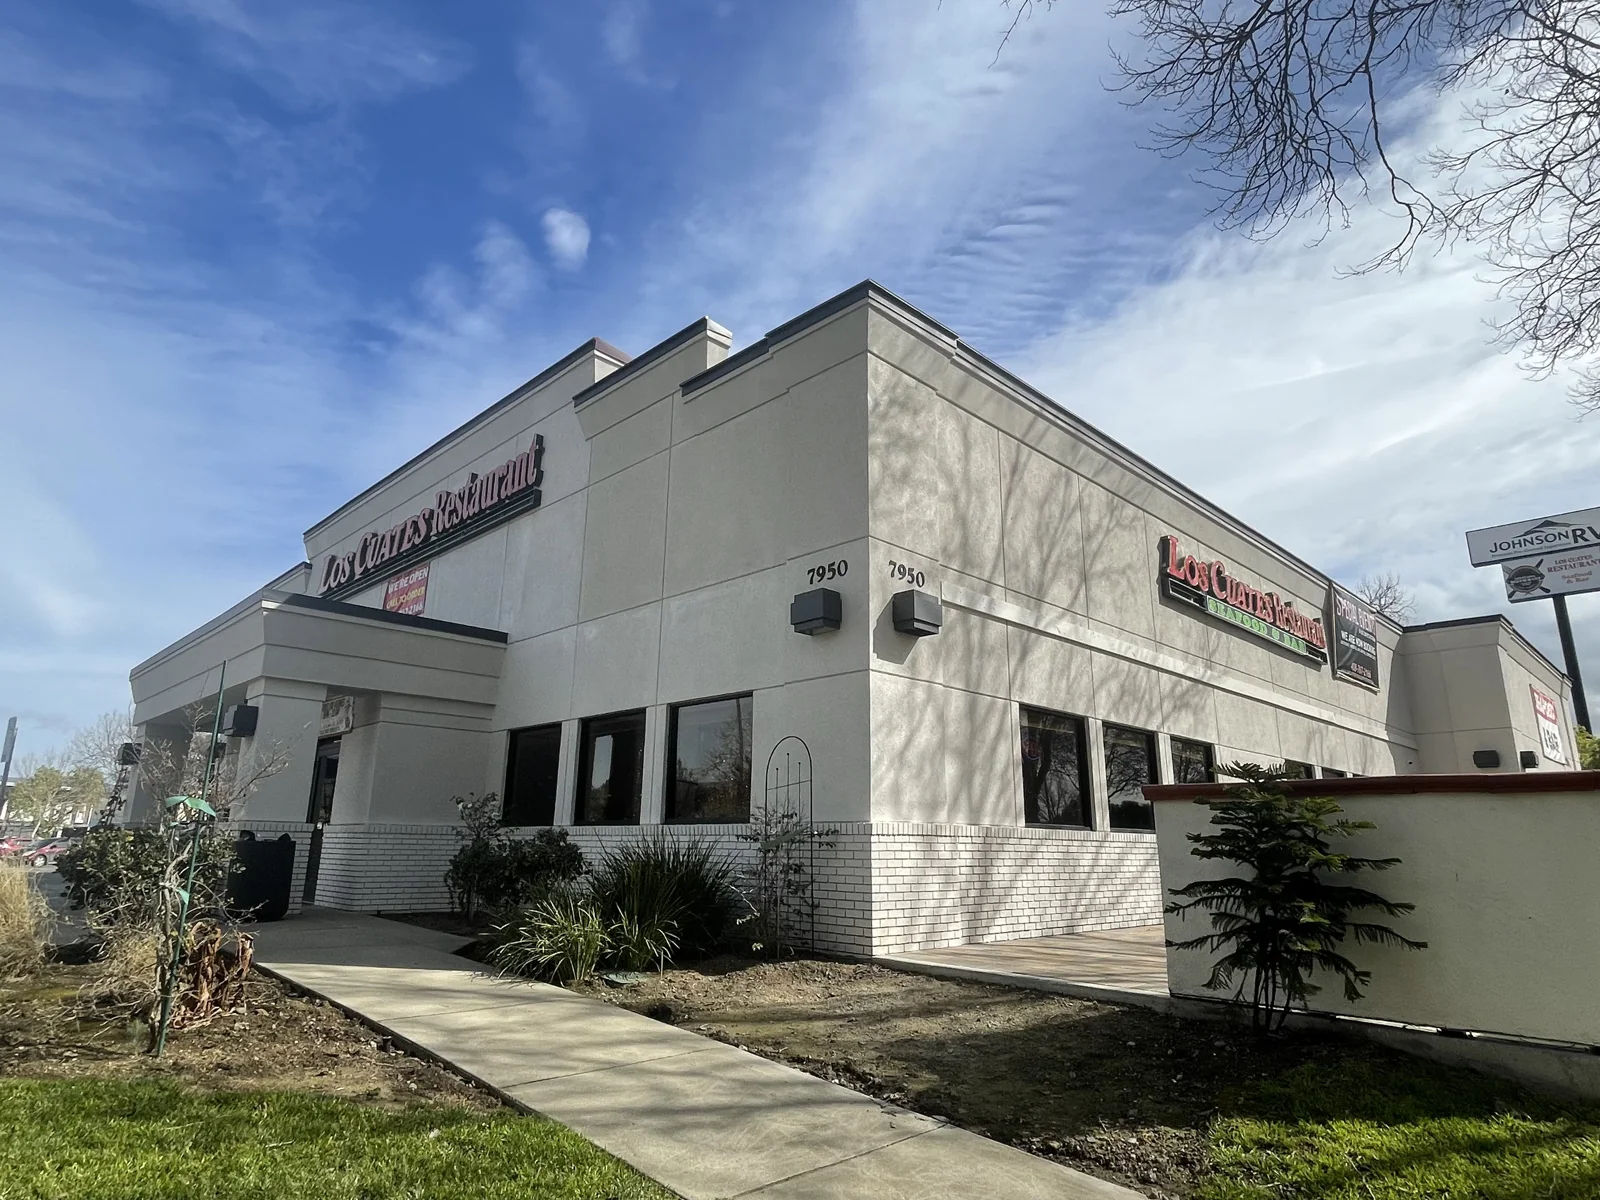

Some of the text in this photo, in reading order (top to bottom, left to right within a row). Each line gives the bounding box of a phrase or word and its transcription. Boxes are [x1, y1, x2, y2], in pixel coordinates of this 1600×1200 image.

[431, 433, 544, 538] Restaurant
[1489, 530, 1570, 553] JOHNSON
[409, 567, 428, 584] OPEN
[807, 560, 848, 585] 7950
[888, 560, 925, 588] 7950
[1547, 559, 1600, 573] RESTAURANT
[386, 598, 399, 609] CALL
[1208, 599, 1268, 635] SEAFOOD
[1284, 634, 1306, 652] BAR
